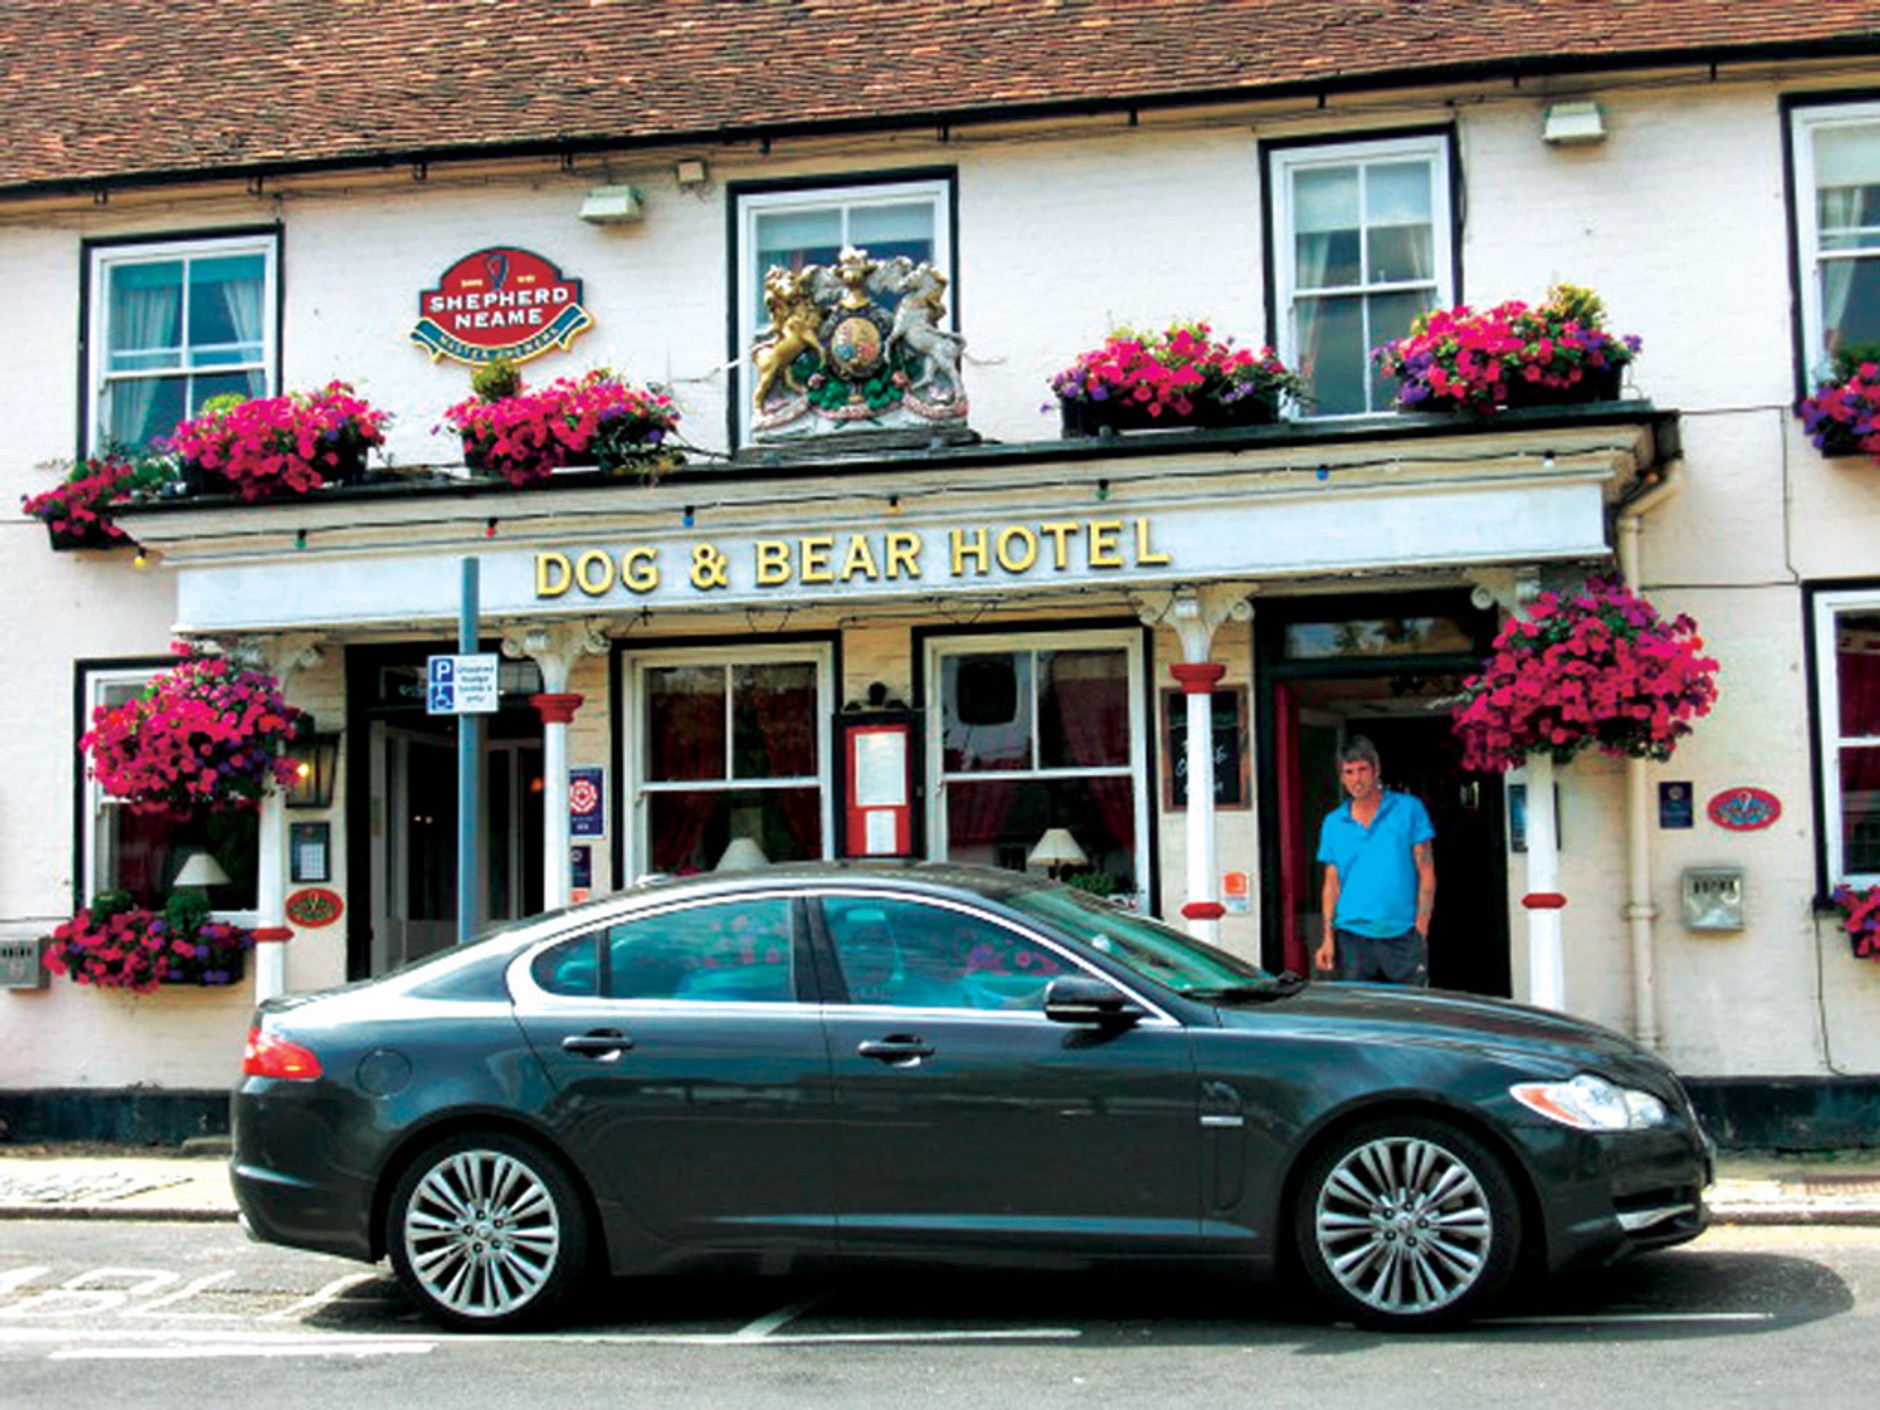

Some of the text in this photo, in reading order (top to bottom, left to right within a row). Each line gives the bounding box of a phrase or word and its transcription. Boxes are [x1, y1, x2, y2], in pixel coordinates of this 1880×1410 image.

[429, 286, 569, 312] SHEPHERD
[454, 308, 543, 330] NEAME
[535, 517, 1172, 599] DOG & BEAR HOTEL
[437, 660, 451, 681] P
